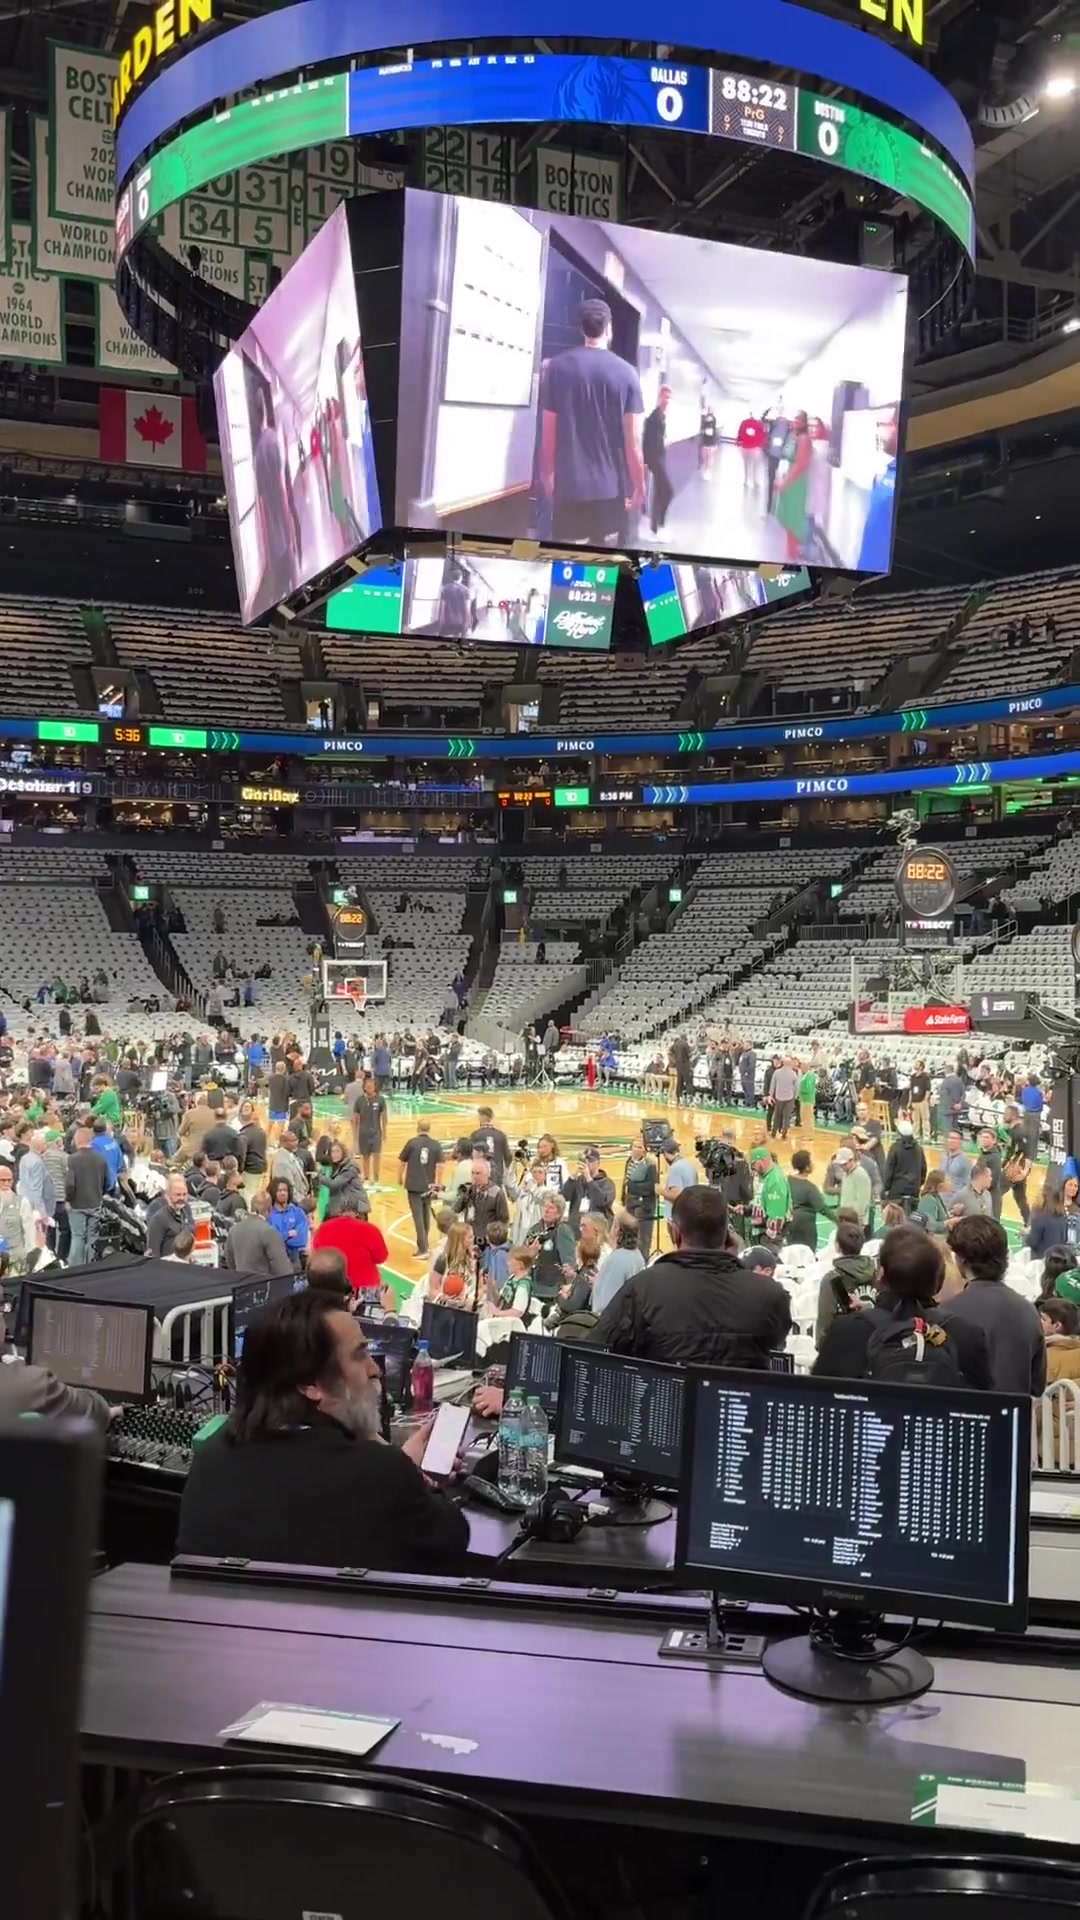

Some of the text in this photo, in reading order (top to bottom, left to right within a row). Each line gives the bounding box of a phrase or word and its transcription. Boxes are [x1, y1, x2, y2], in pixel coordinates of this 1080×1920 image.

[112, 0, 212, 130] ARDEN
[651, 66, 687, 85] DALLAS
[66, 66, 115, 96] BOST
[722, 77, 787, 110] 88:22
[68, 96, 115, 125] CELT
[656, 87, 683, 122] 0
[744, 106, 765, 120] PrG
[427, 126, 465, 162] 22
[818, 122, 838, 155] 0
[91, 147, 115, 165] 202
[313, 146, 350, 177] 19
[476, 138, 504, 166] 14
[83, 165, 116, 185] WOR
[546, 163, 612, 195] BOSTON
[67, 181, 116, 204] CHAMP
[246, 171, 282, 205] 31
[548, 189, 611, 218] CETICS
[189, 203, 231, 238] 34
[253, 215, 274, 245] 5
[61, 224, 109, 245] WORLD
[44, 239, 115, 264] CHAMPION
[180, 244, 224, 262] WRLD
[7, 296, 33, 312] 1964
[0, 328, 58, 347] AMPIONS
[1009, 698, 1042, 713] PIMCO
[115, 729, 140, 742] 5:36
[784, 727, 823, 739] PIMCO
[324, 741, 363, 752] PIMCO
[557, 741, 595, 751] PIMCO
[619, 791, 633, 801] PM
[796, 779, 848, 794] PIMCO
[907, 863, 944, 880] 88:22
[993, 1001, 1015, 1011] ESPN
